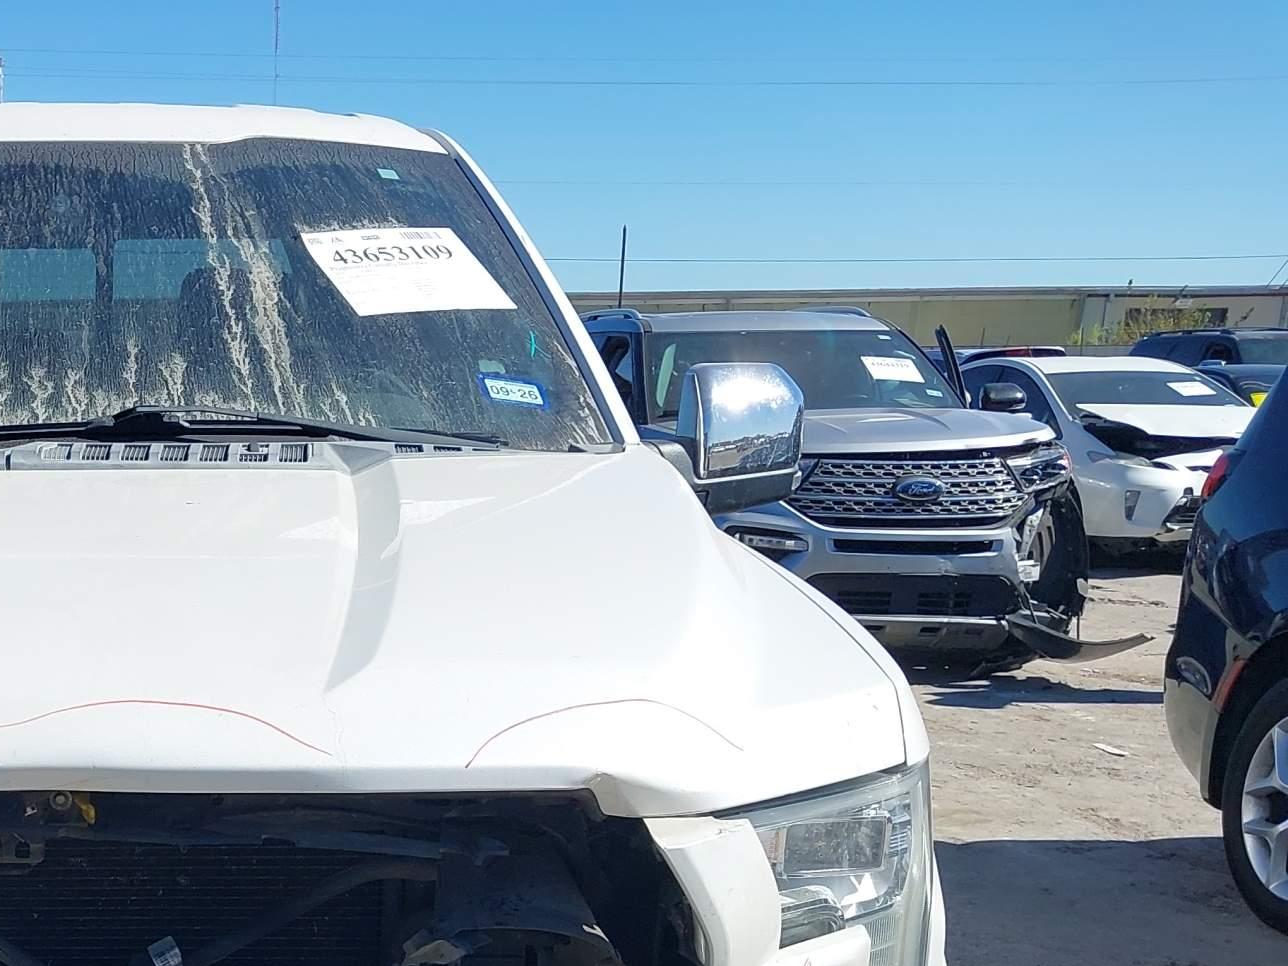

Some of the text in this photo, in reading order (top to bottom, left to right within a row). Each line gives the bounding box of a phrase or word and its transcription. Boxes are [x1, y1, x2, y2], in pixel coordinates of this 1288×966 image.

[332, 244, 453, 265] 43653109
[489, 384, 539, 400] 09-26
[908, 483, 935, 495] Ford
